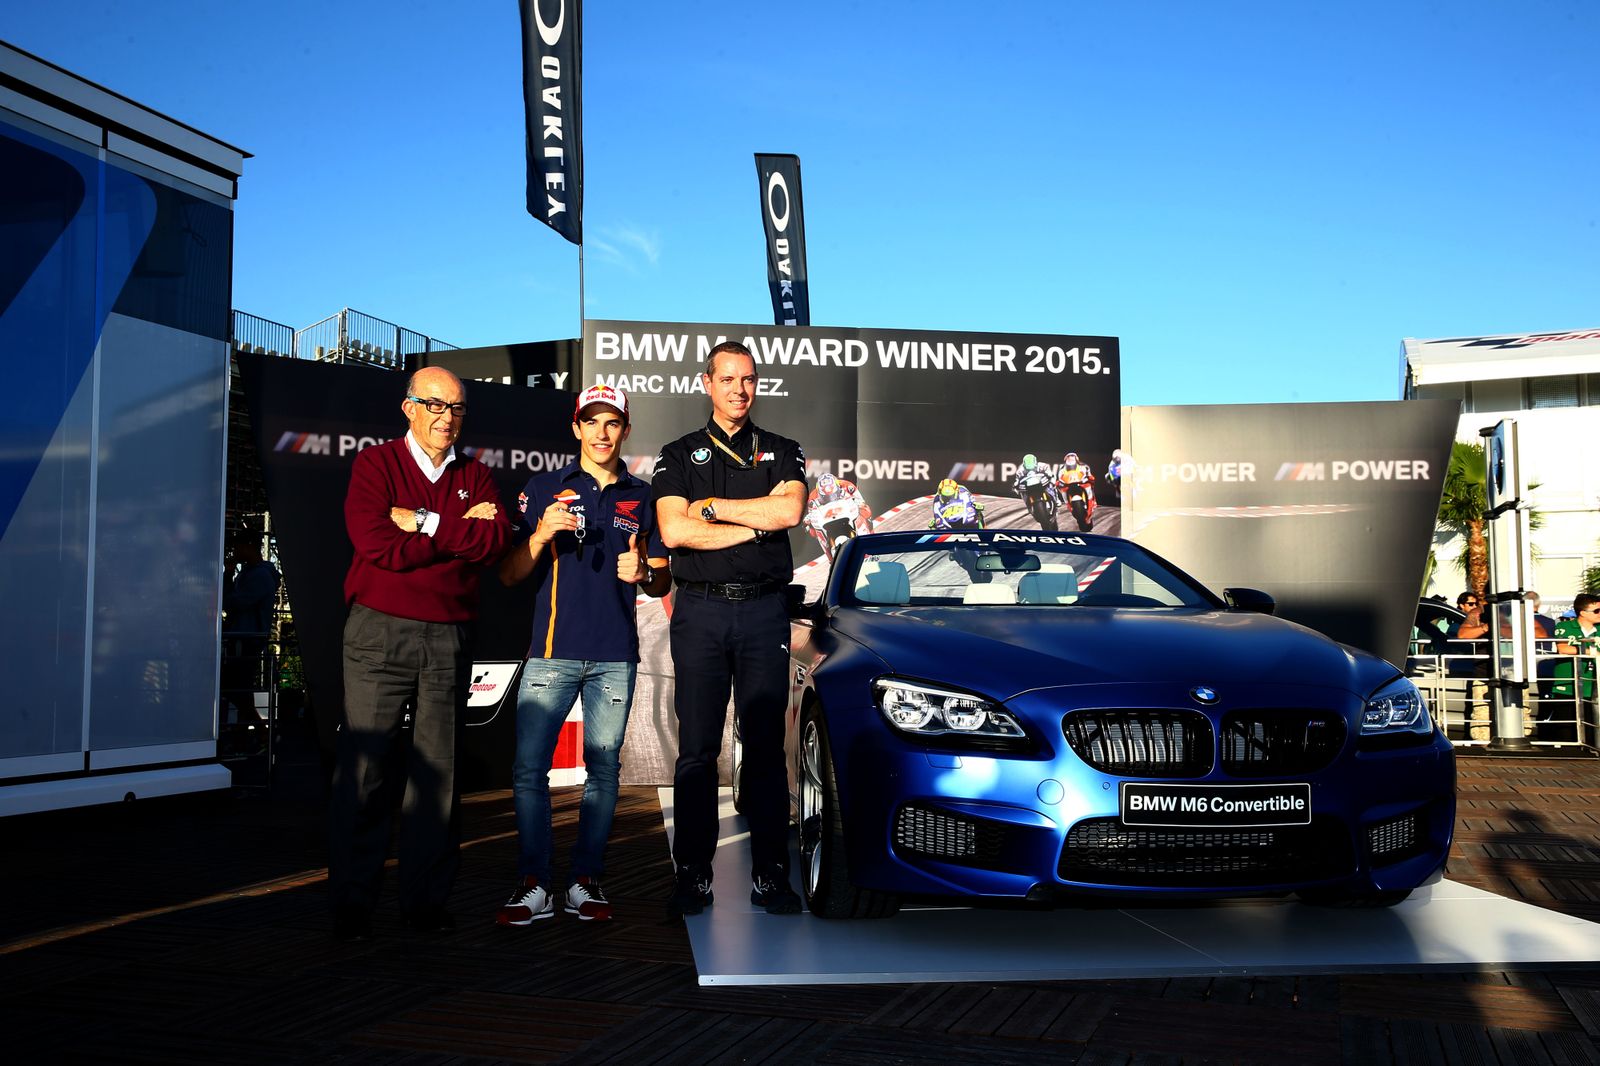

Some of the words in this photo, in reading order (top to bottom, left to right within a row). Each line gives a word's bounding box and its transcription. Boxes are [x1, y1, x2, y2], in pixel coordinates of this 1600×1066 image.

[595, 332, 688, 362] BMW
[741, 336, 869, 367] AWARD
[875, 341, 1017, 372] WINNER
[1024, 350, 1110, 375] 2015.
[595, 374, 664, 393] MARC
[670, 373, 789, 397] MÁEZ.
[586, 392, 600, 401] Red
[601, 391, 617, 401] Bull
[837, 460, 931, 480] POWER
[1160, 463, 1257, 483] POWER
[1331, 460, 1430, 481] POWER
[992, 533, 1087, 546] Award
[1130, 795, 1178, 811] BMW
[1180, 797, 1208, 812] M6
[1210, 795, 1305, 812] Convertible
